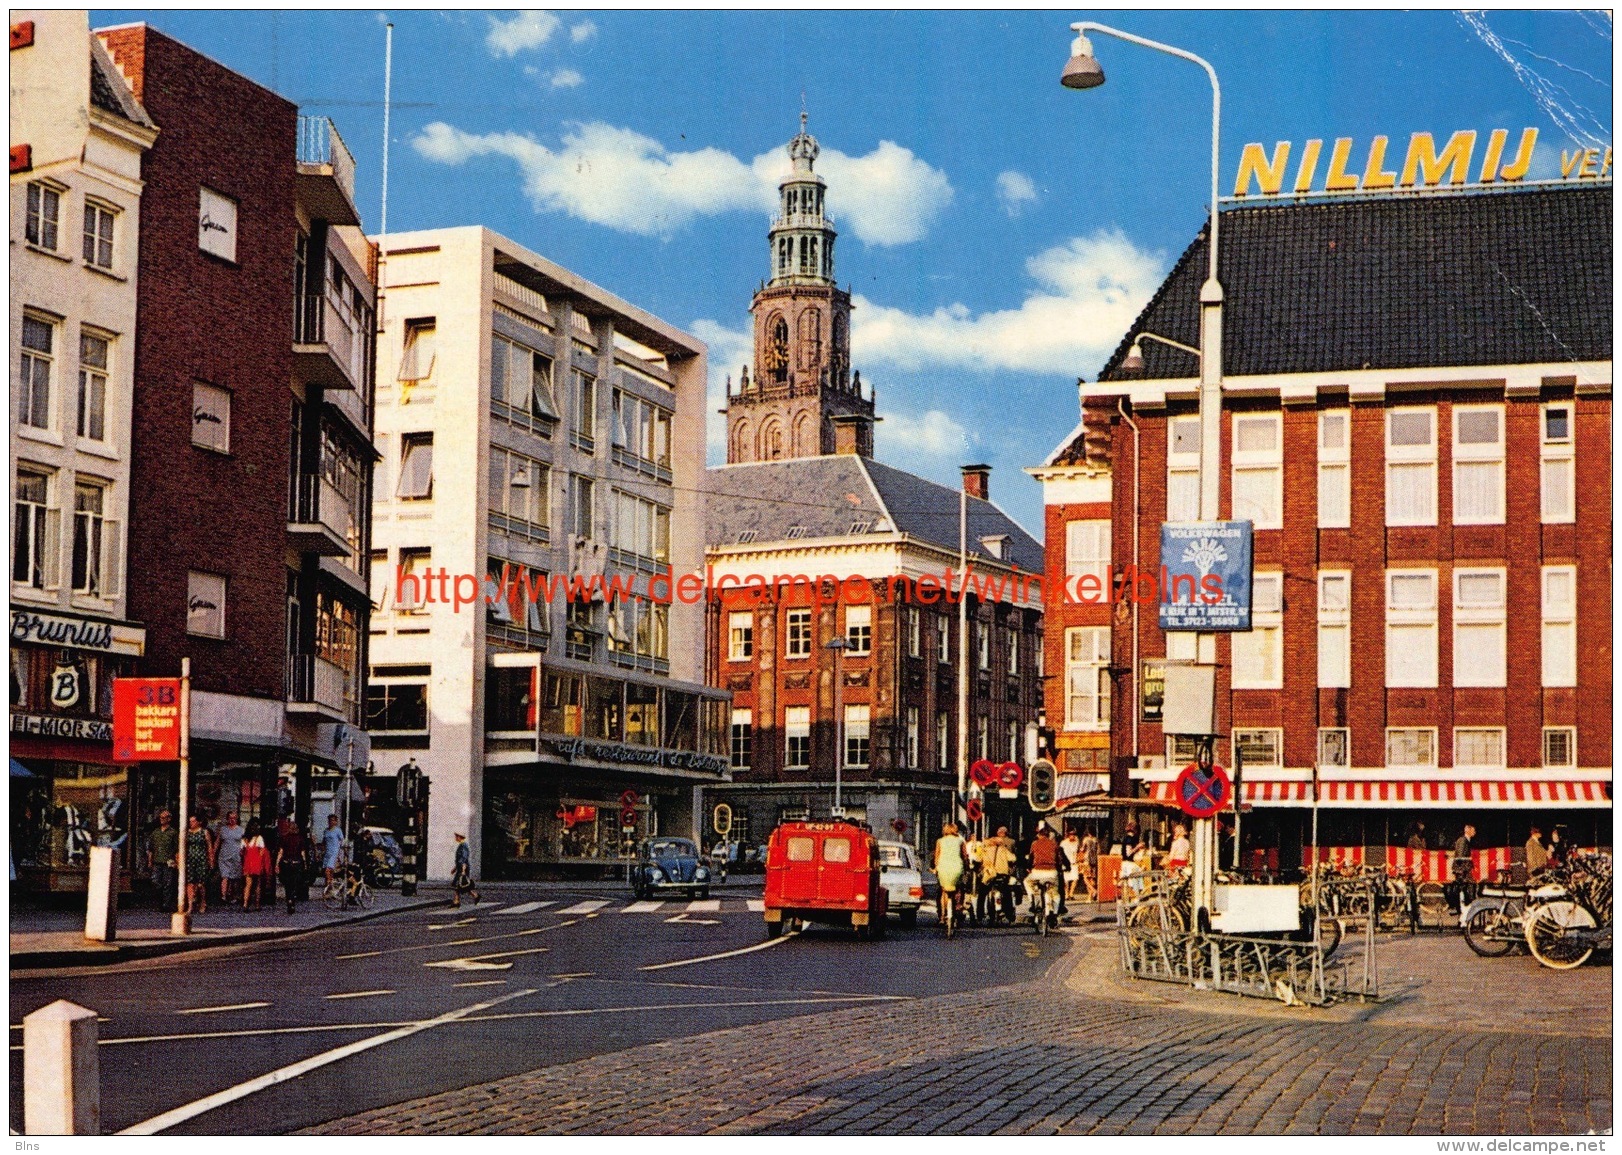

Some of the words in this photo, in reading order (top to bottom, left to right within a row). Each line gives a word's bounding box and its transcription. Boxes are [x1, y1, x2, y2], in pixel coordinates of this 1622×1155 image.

[1234, 127, 1540, 197] NILLMIJ
[1170, 529, 1241, 538] VOLKSWAGEN
[55, 672, 75, 701] B
